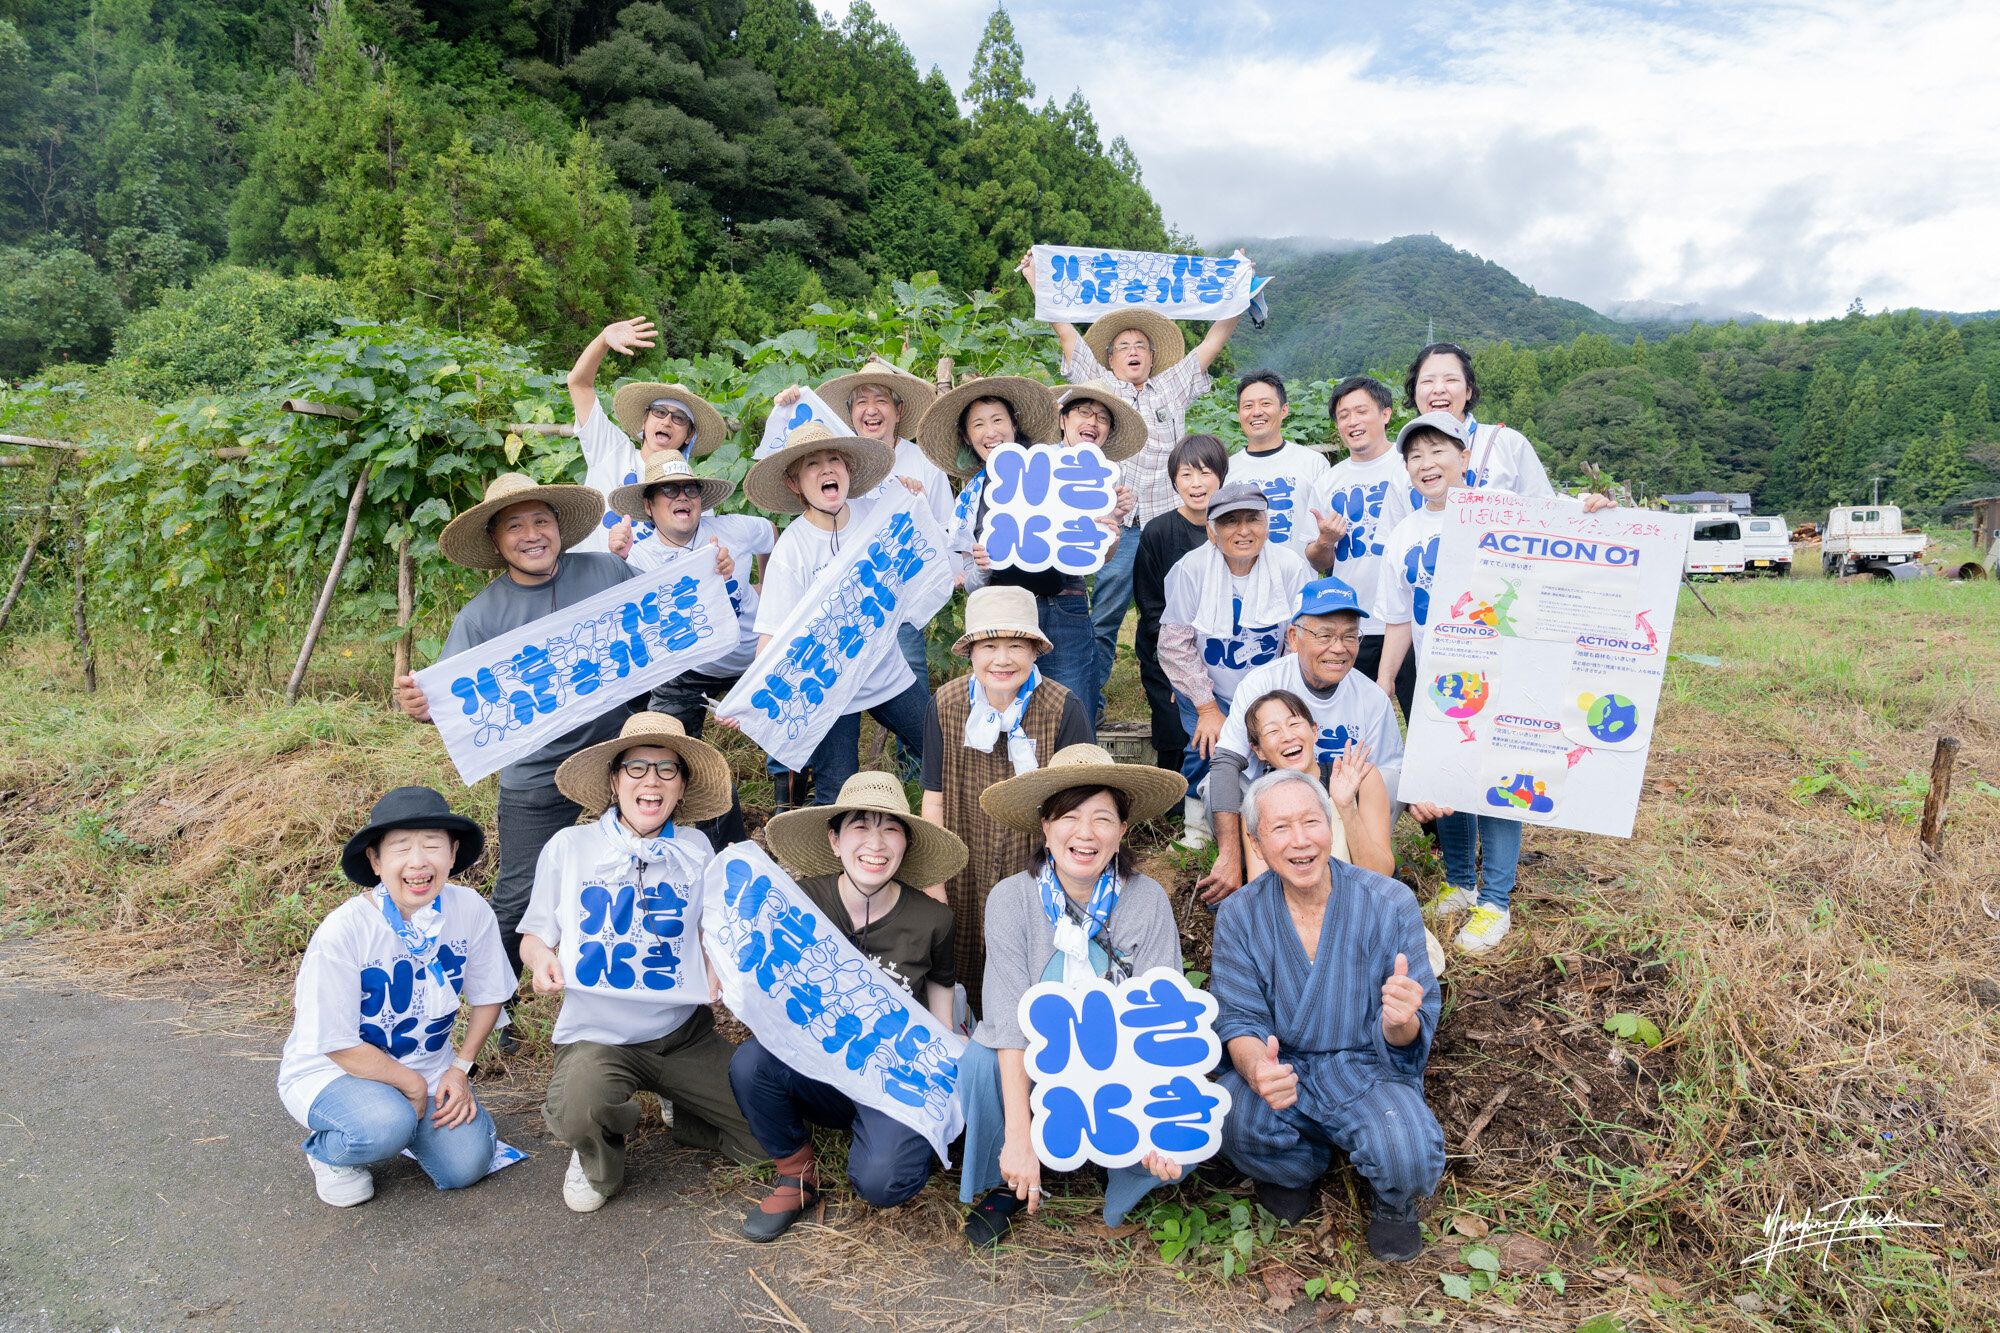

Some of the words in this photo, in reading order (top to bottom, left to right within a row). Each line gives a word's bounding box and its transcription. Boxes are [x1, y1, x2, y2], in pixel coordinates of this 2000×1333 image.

[1478, 532, 1598, 562] ACTION
[1605, 546, 1640, 567] 01
[1435, 625, 1477, 635] ACTION
[1478, 628, 1495, 637] 02
[1577, 635, 1629, 649] ACTION
[1631, 642, 1651, 652] 04
[1496, 714, 1542, 728] ACTION
[1543, 721, 1561, 731] 03
